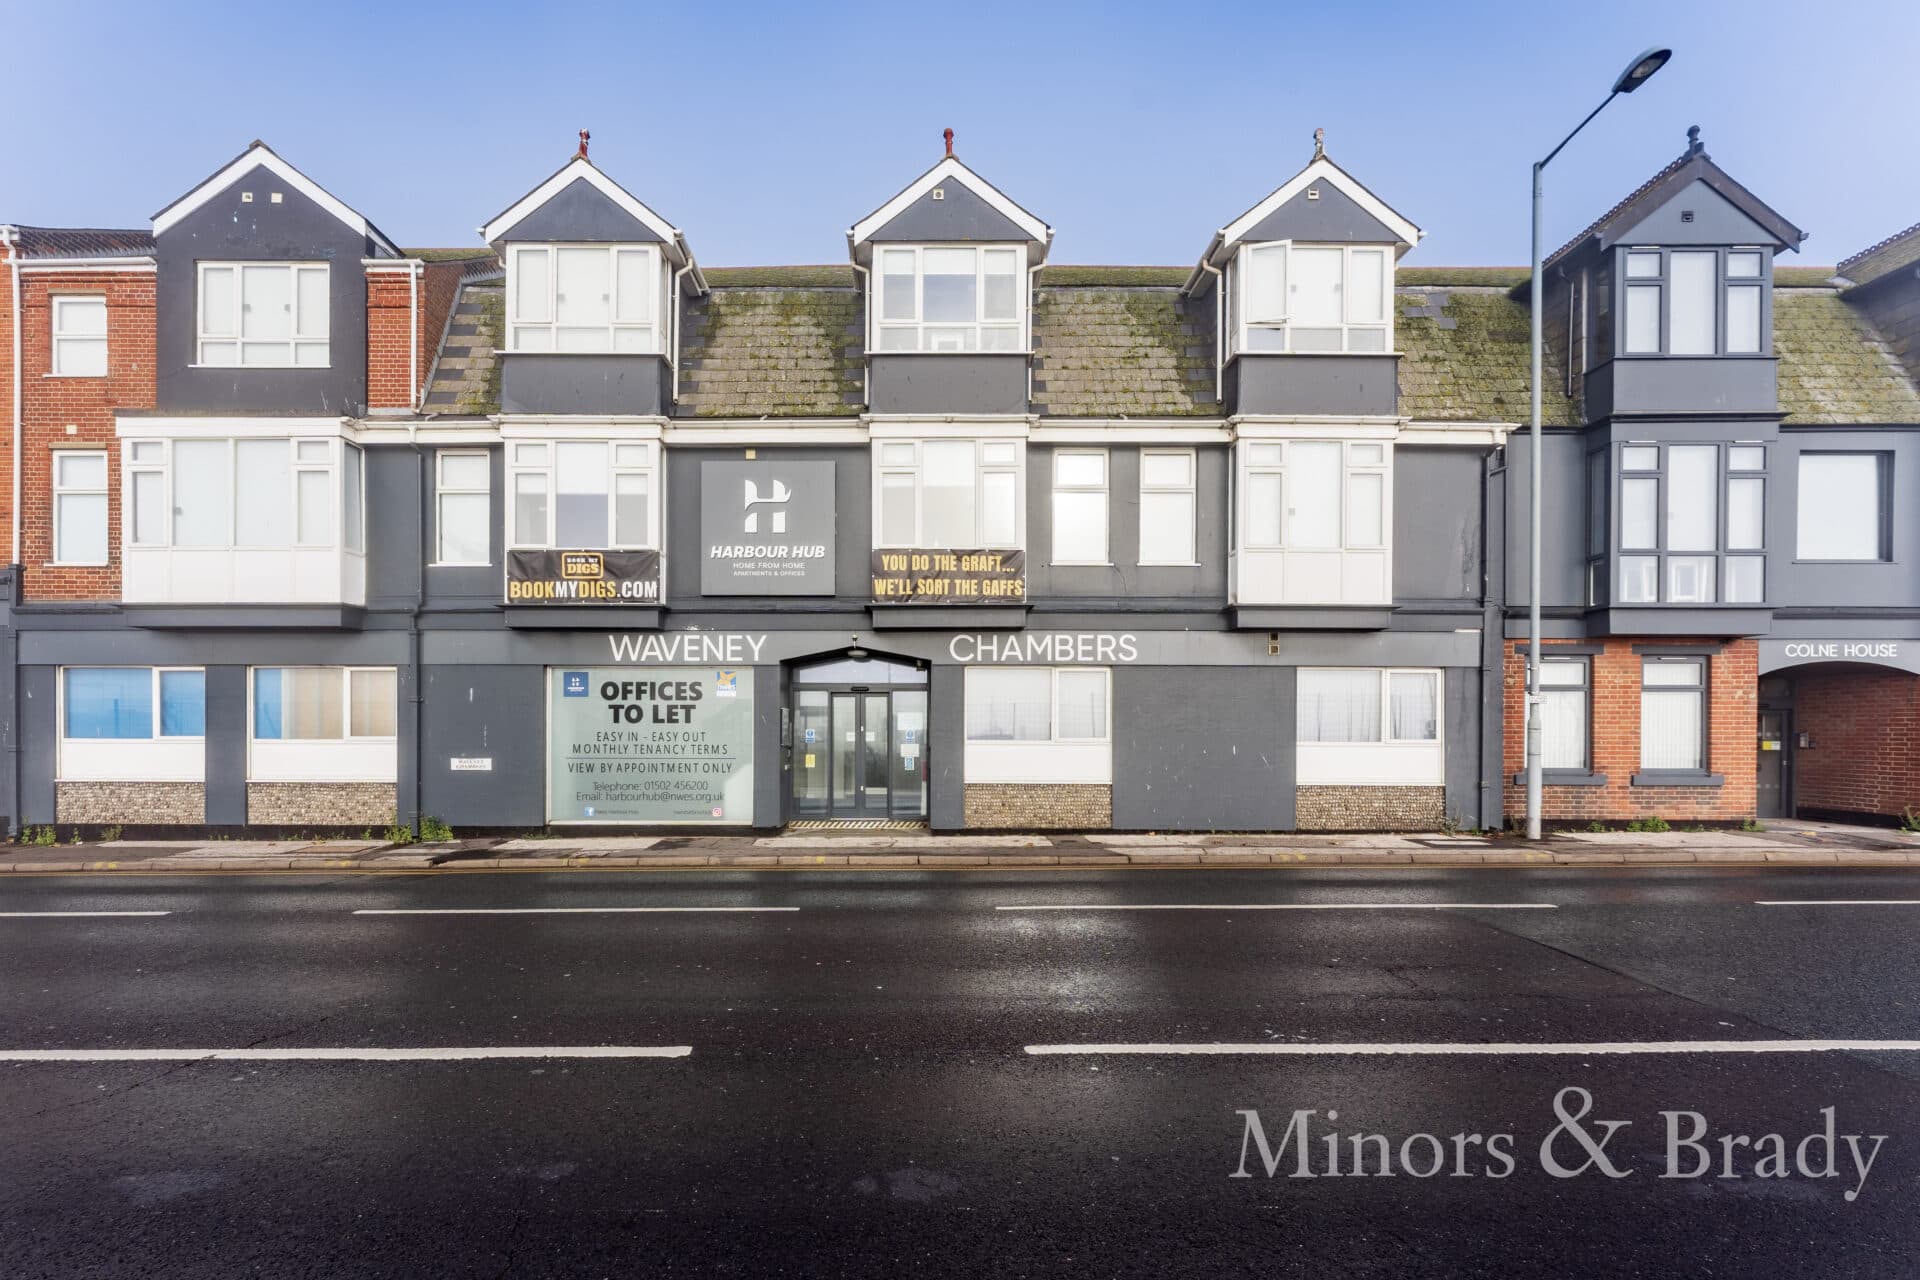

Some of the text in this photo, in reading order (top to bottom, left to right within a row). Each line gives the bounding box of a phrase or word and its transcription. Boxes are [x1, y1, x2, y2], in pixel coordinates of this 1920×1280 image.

[711, 545, 825, 558] HARBOUR HUB
[567, 563, 599, 574] DIGS
[882, 554, 1015, 572] YOU DO THE GRAFT...
[510, 580, 658, 598] BOOKMYDIGS.COM
[874, 578, 1024, 596] WE'LL SORT THE GAFFS
[608, 633, 1138, 662] WAVENEY CHAMBERS
[1785, 643, 1898, 657] COLNE HOUSE
[600, 681, 703, 701] OFFICES
[608, 704, 697, 724] TO LET
[596, 731, 623, 742] EASY
[628, 731, 639, 742] IN
[652, 731, 678, 742] EASY
[682, 731, 706, 742] OUT
[572, 744, 729, 755] MONTHLY TENANCY TERMS
[568, 762, 733, 773] VIEW BY APPOINTMENT ONLY
[593, 781, 709, 792] Telephone: 01502 456200
[576, 791, 603, 801] Email:
